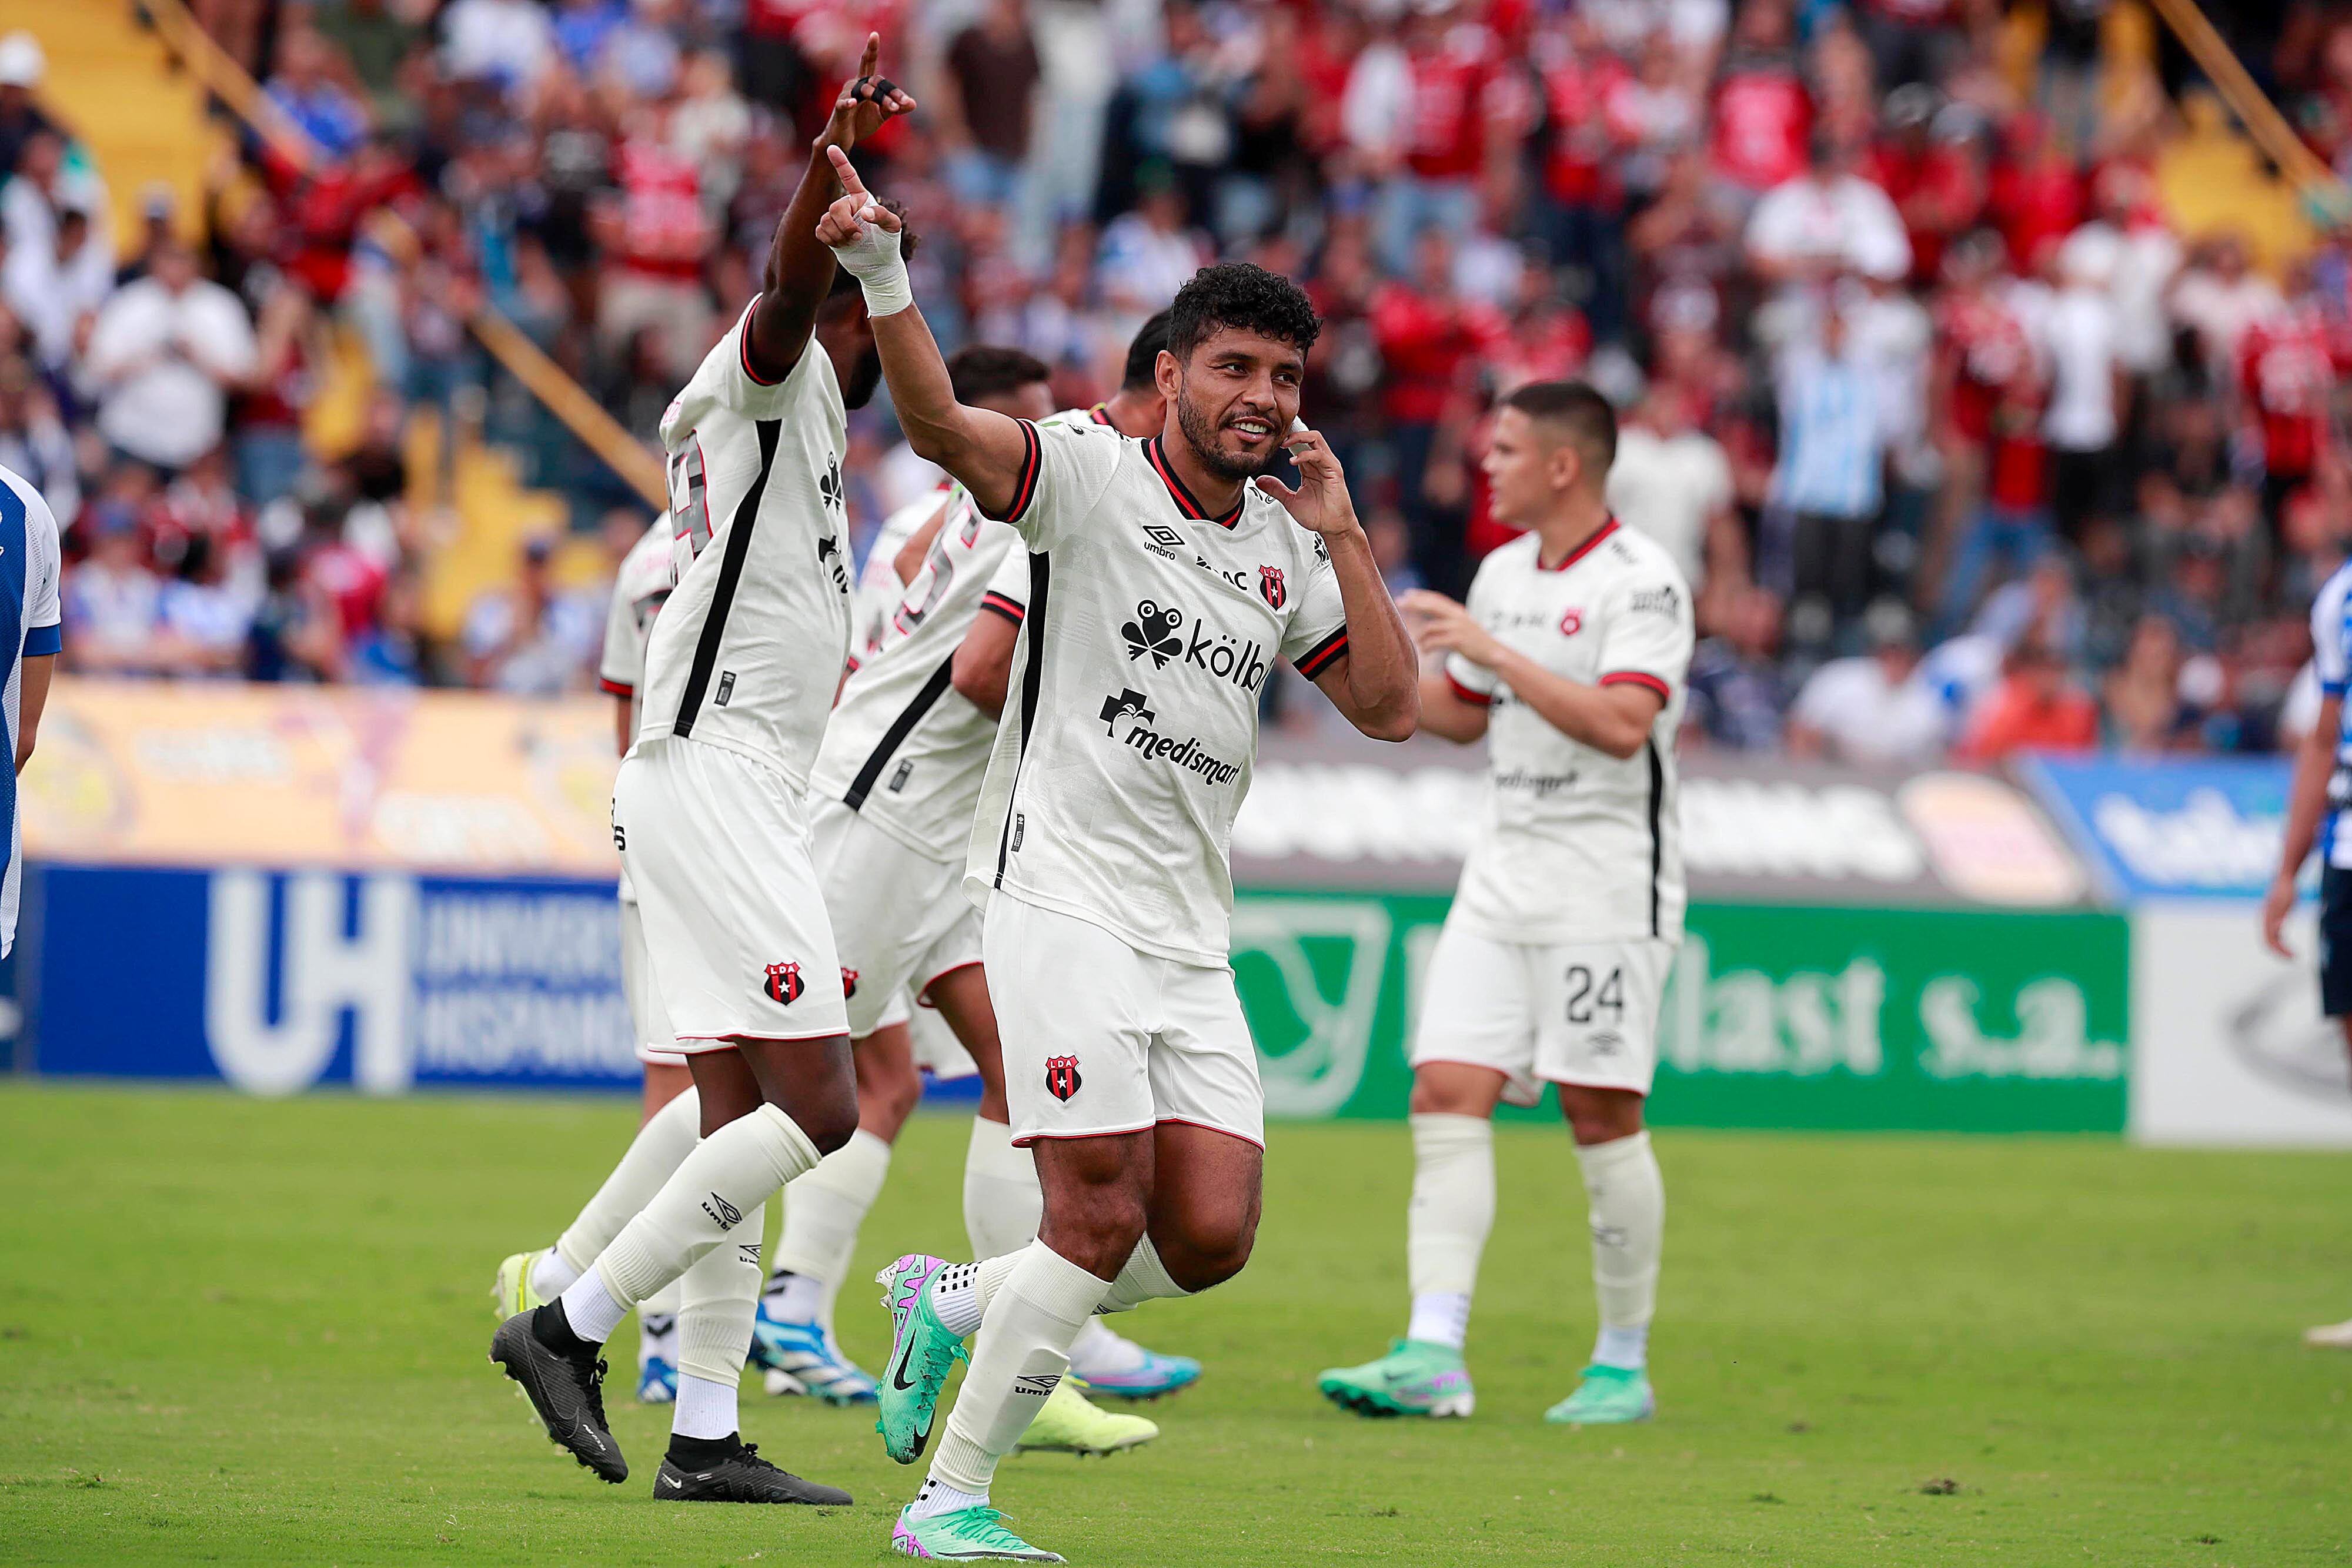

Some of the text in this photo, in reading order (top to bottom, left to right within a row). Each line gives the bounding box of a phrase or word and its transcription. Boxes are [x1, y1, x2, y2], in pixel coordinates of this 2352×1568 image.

[1144, 541, 1176, 560] umbro
[1263, 568, 1281, 580] LDA
[1124, 726, 1244, 786] medismart
[770, 965, 796, 975] LDA
[1565, 965, 1624, 1024] 24
[1050, 1059, 1073, 1069] LDA
[701, 1201, 731, 1232] umbr
